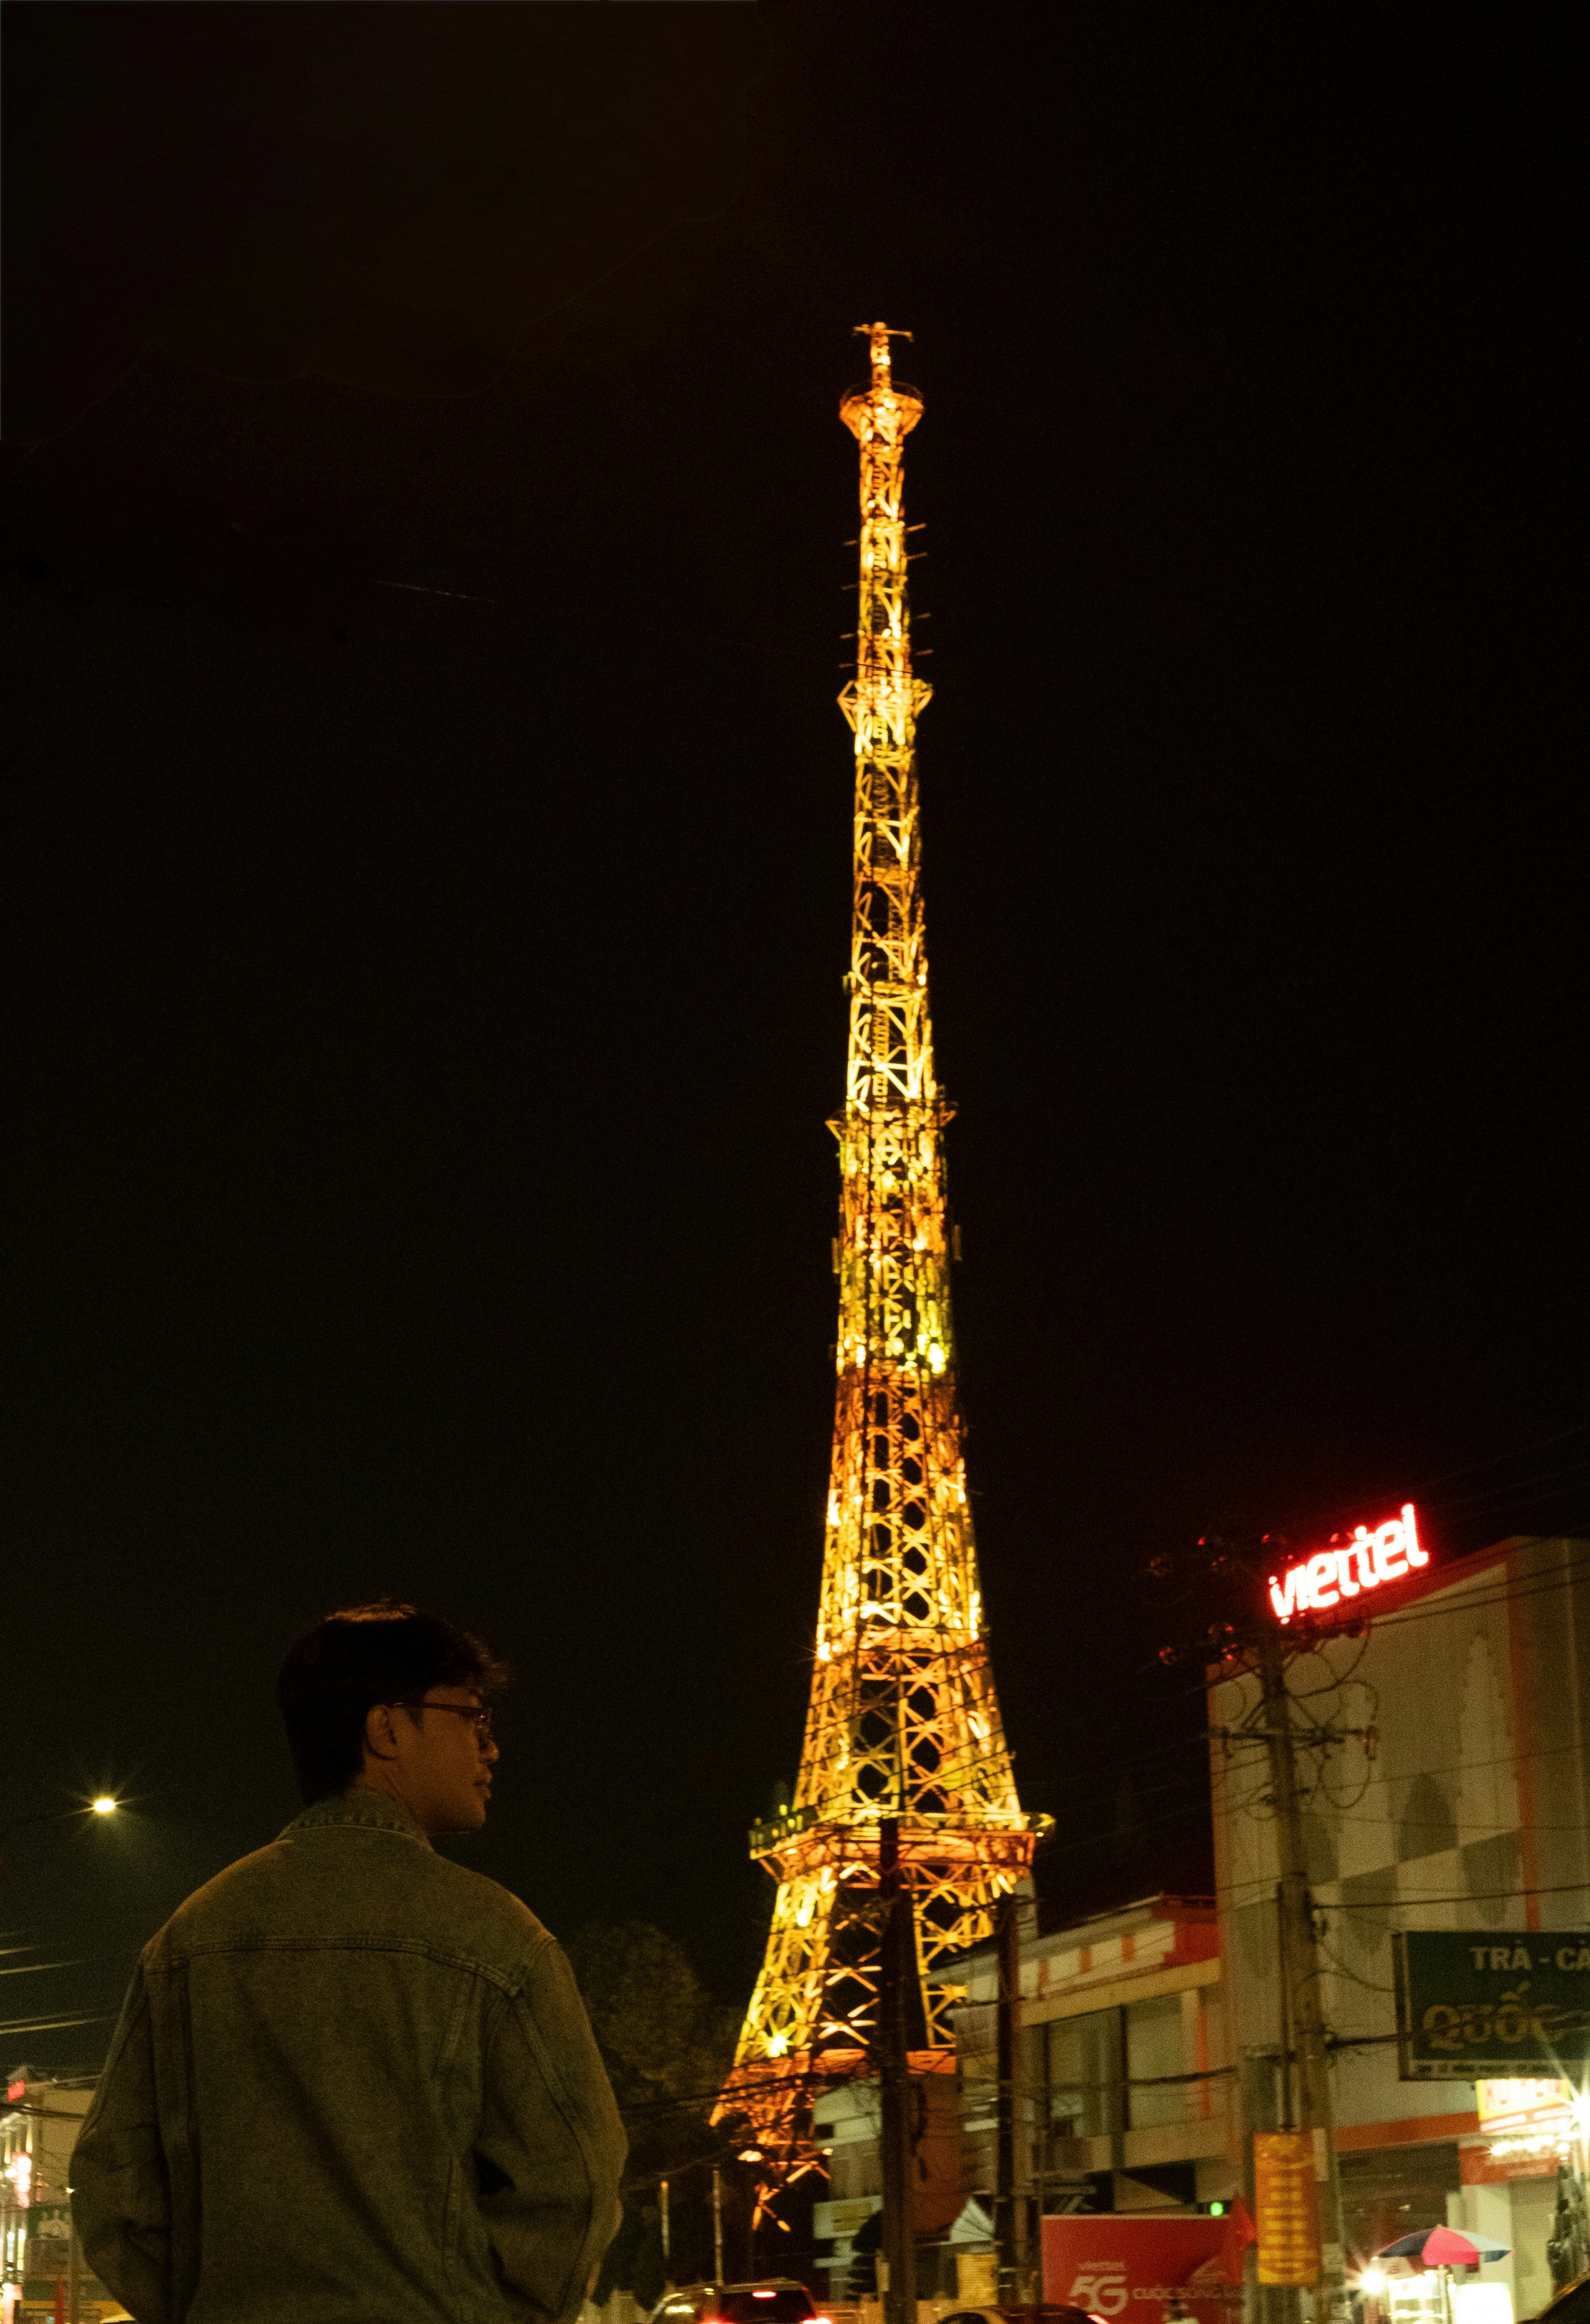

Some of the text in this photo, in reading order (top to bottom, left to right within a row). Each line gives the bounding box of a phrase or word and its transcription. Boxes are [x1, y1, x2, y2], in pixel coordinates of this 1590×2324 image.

[1269, 1504, 1429, 1617] viettel
[1470, 1938, 1532, 1971] TRÀ
[1070, 2275, 1128, 2316] 5G
